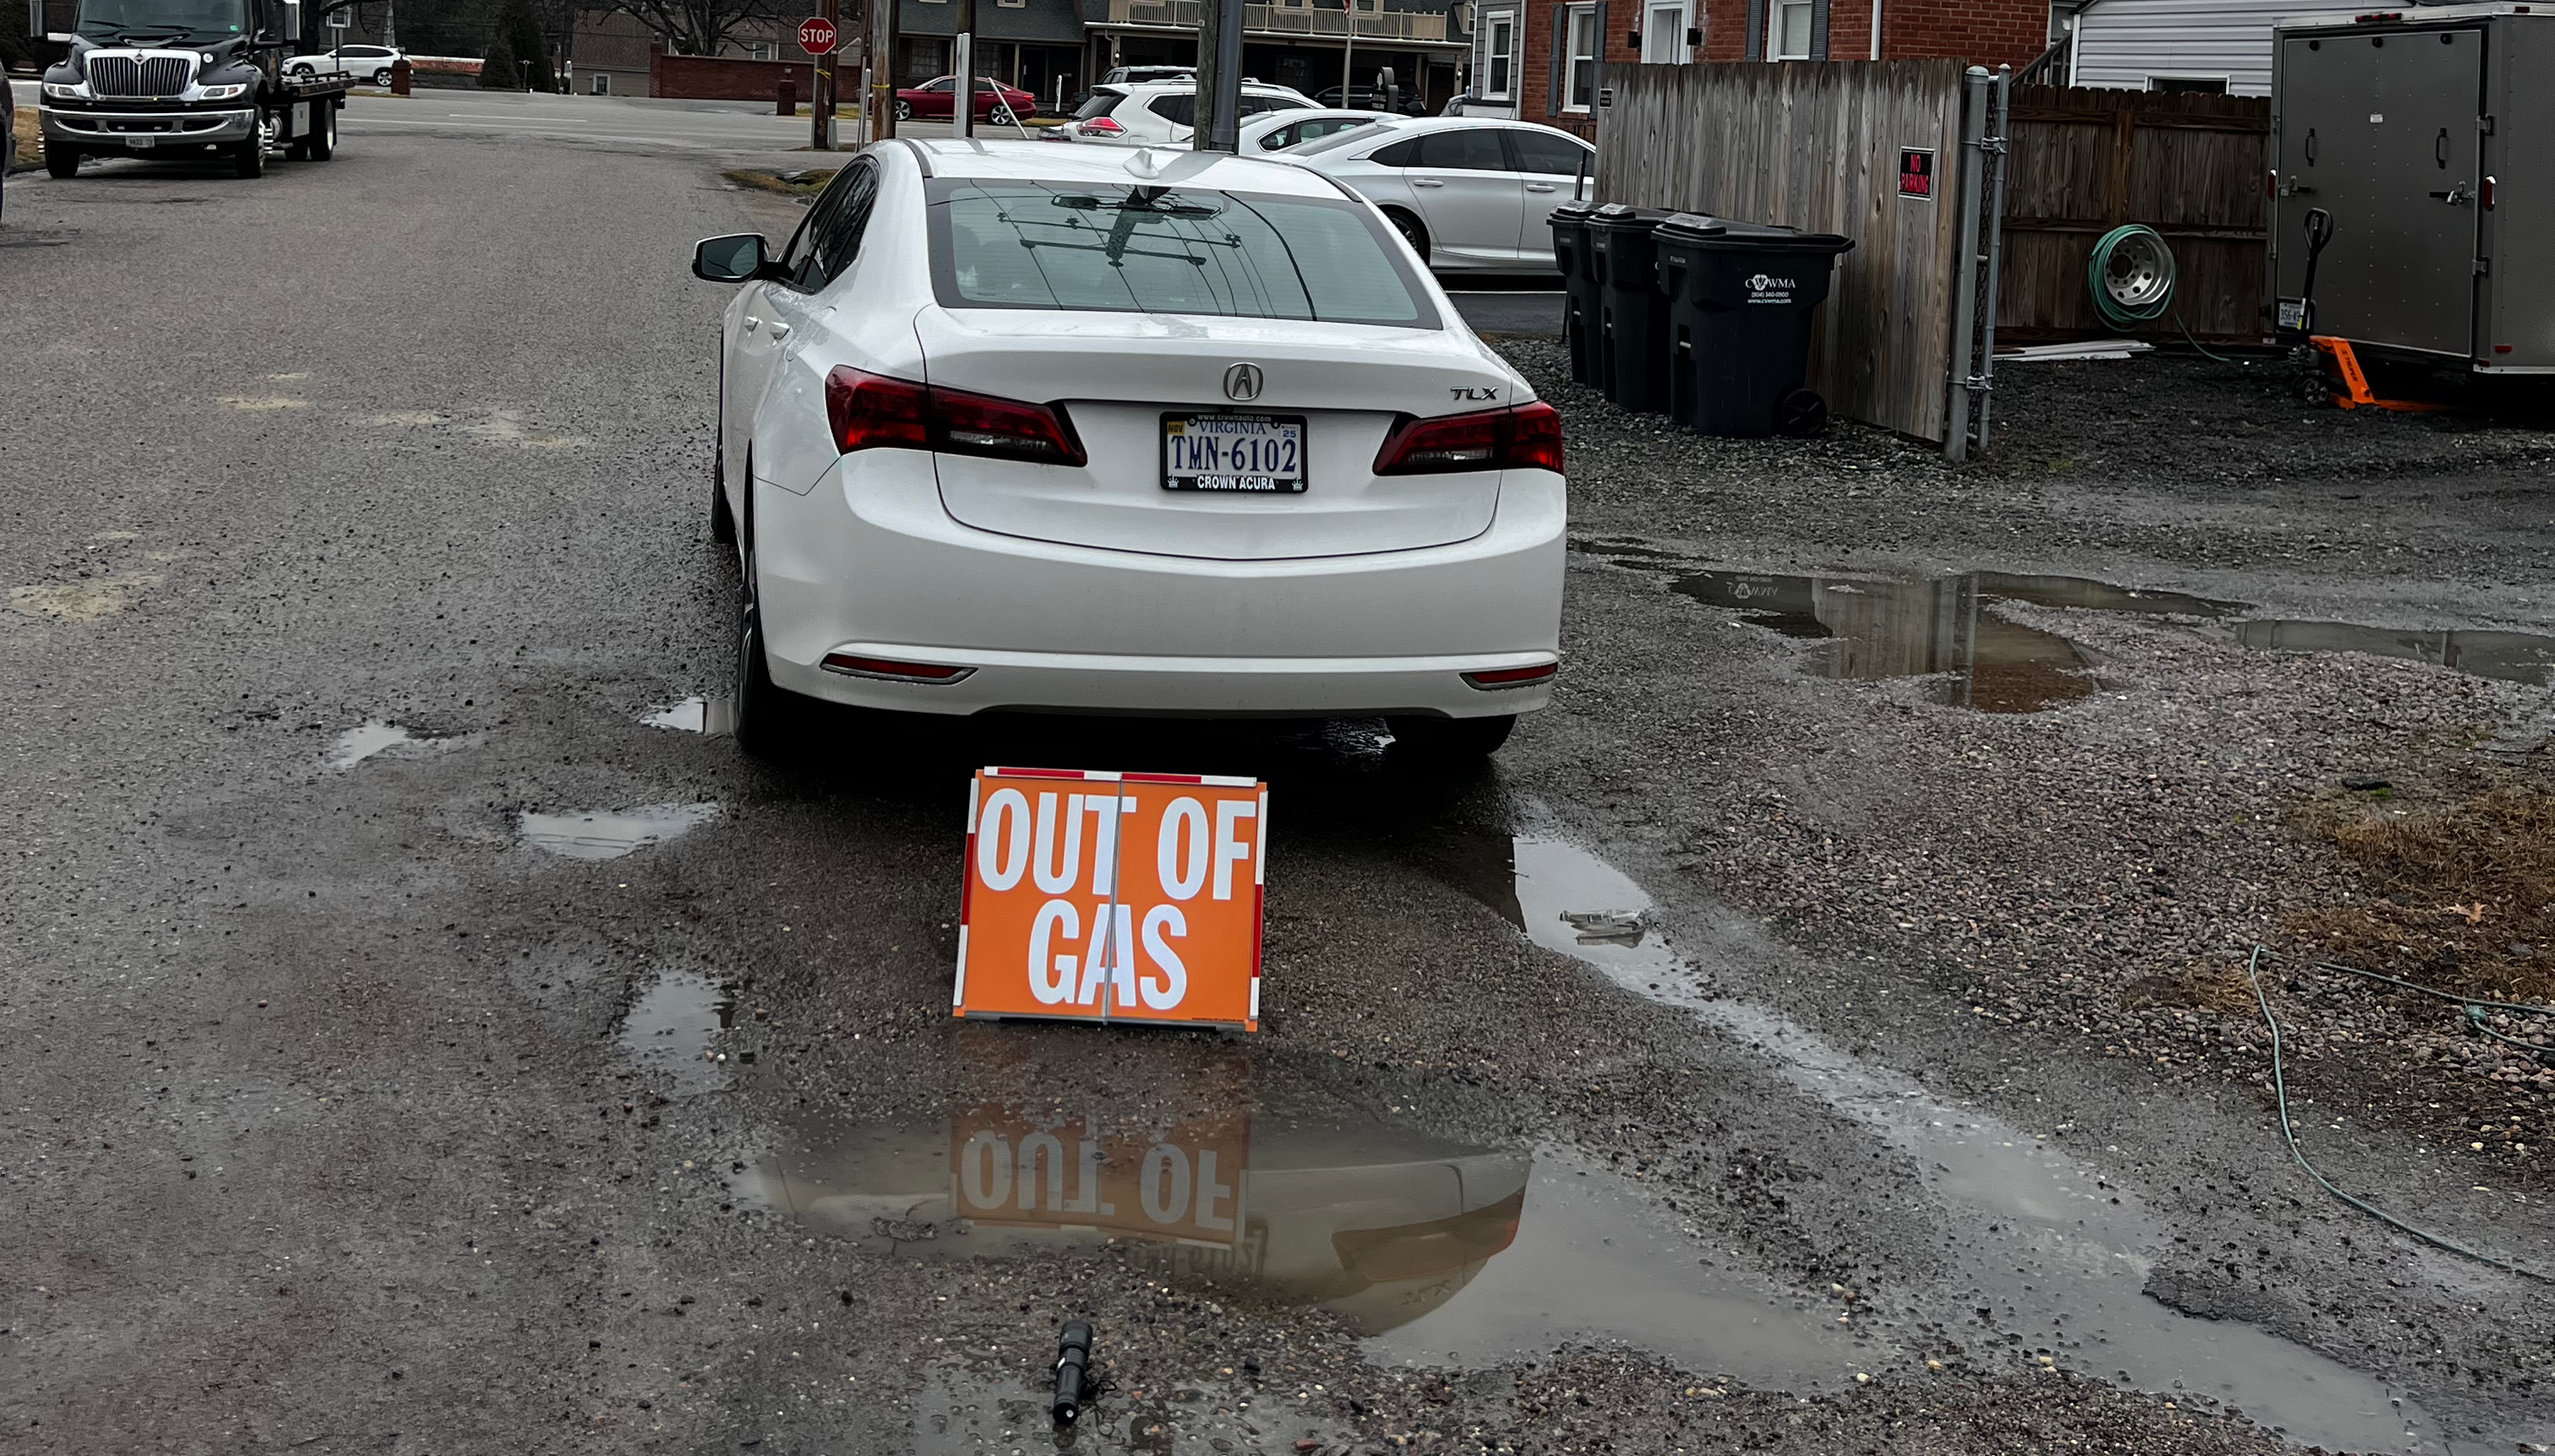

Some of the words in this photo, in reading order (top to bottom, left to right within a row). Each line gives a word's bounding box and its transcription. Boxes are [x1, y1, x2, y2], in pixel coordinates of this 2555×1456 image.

[801, 28, 834, 43] STOP
[1909, 153, 1921, 173] NO
[1900, 172, 1929, 194] PARKING
[1745, 275, 1796, 289] CVWMA
[1450, 386, 1499, 400] TLX
[1197, 421, 1268, 435] VIRGINIA
[1283, 429, 1296, 438] 25
[1171, 435, 1296, 473] TMN-6102
[1197, 475, 1236, 490] CROWN
[1238, 476, 1276, 490] ACURA
[977, 788, 1137, 896] OUT
[1157, 796, 1256, 900] OF
[1028, 898, 1187, 1010] GAS
